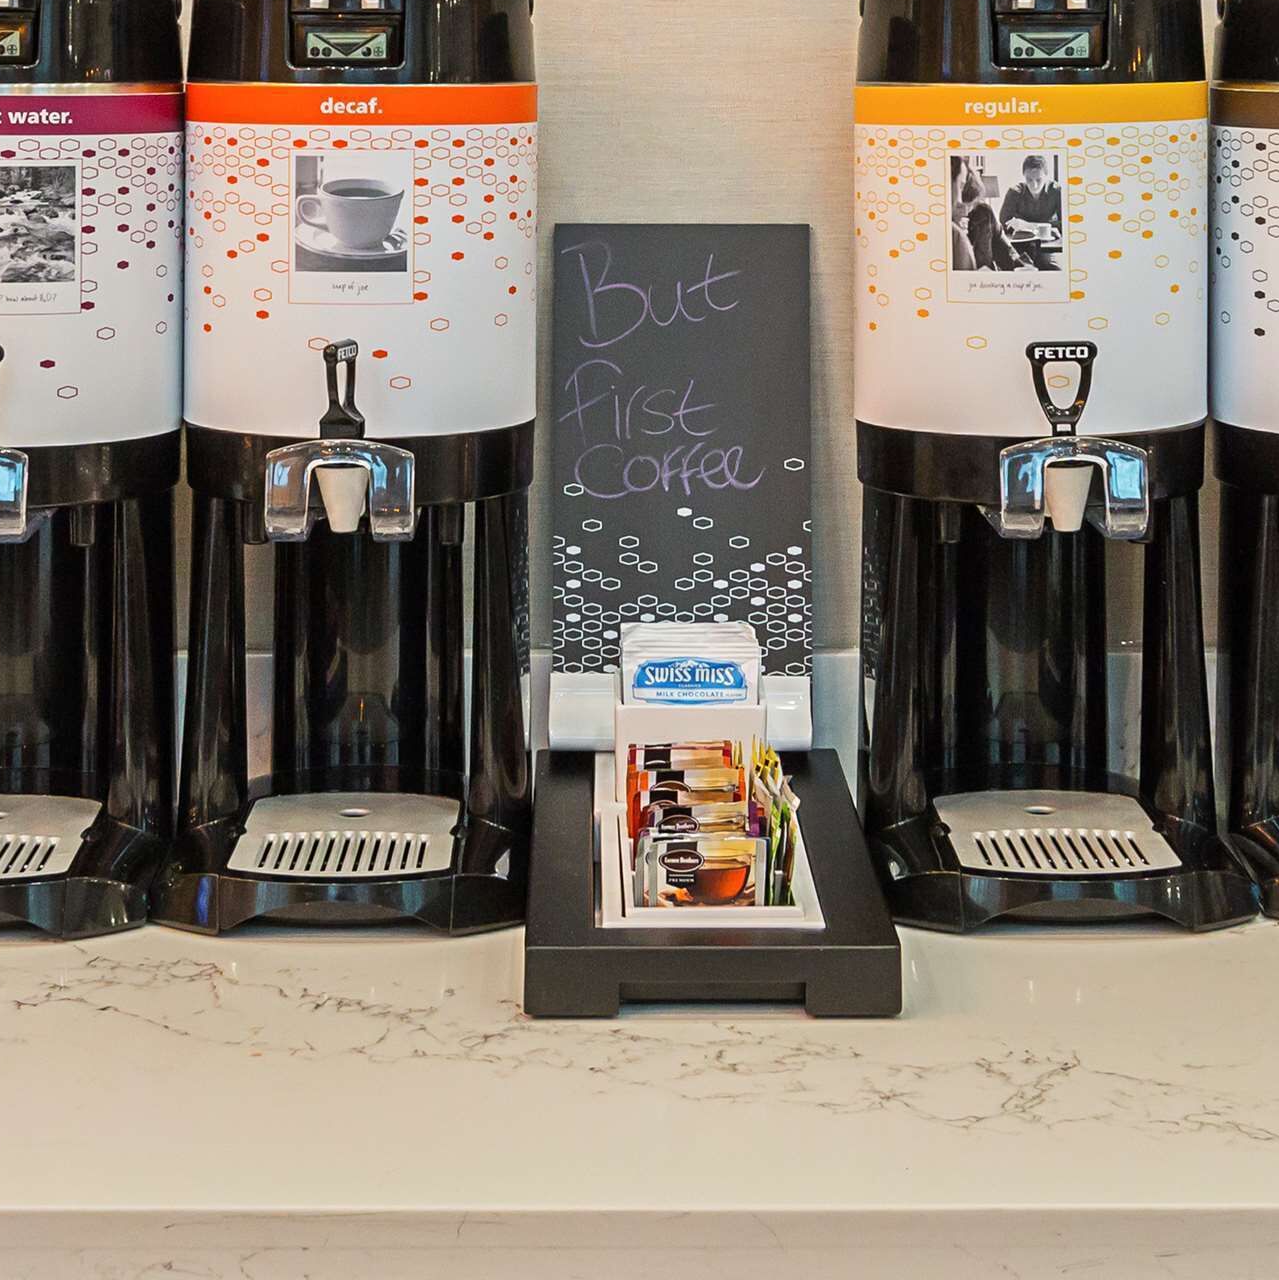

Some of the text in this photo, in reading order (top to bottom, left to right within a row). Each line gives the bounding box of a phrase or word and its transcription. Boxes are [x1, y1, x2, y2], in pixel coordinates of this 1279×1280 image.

[320, 97, 383, 114] decaf.
[964, 97, 1042, 118] regular.
[8, 108, 73, 124] water.
[561, 240, 740, 348] But
[1034, 346, 1089, 359] FETCO
[559, 360, 718, 444] First
[575, 442, 766, 499] Coffee
[644, 666, 734, 686] SWISS MISS
[677, 690, 724, 698] CHOCOLATE
